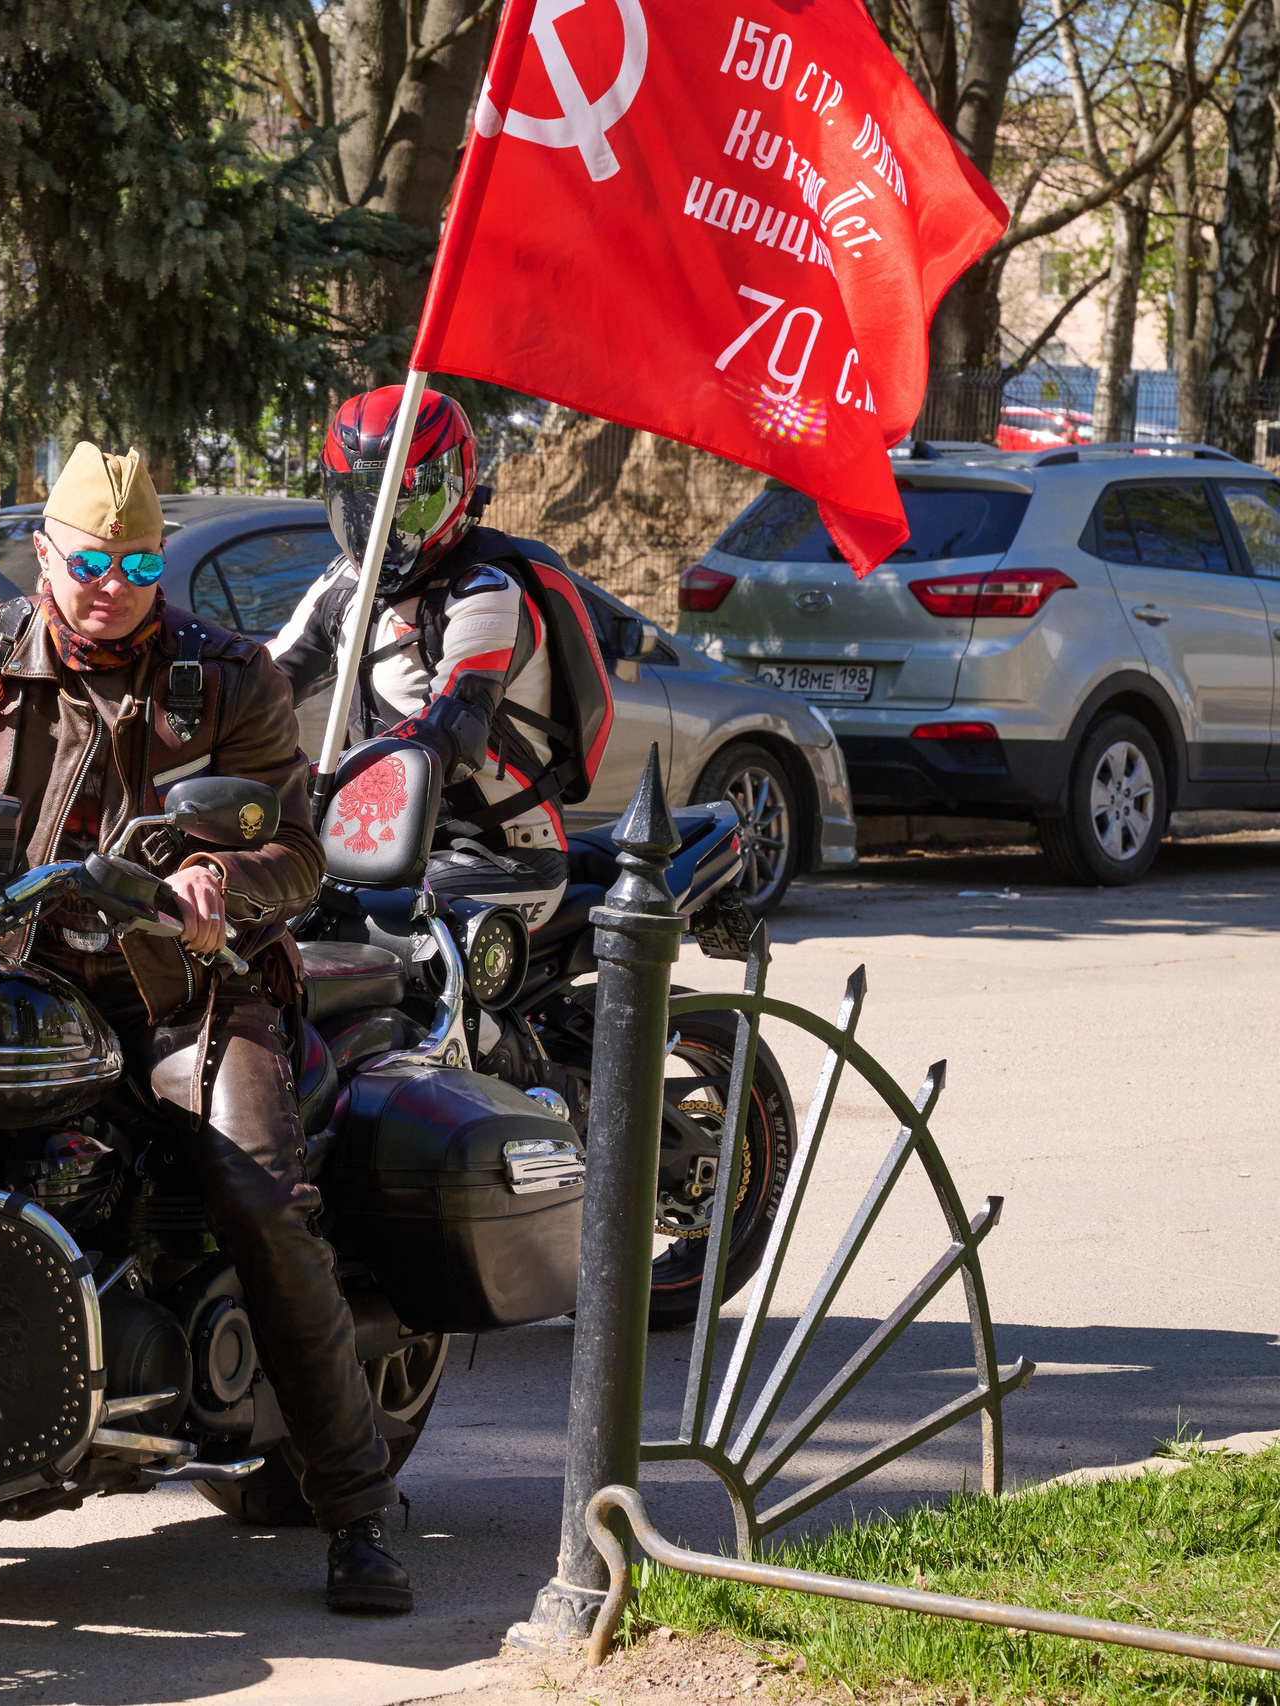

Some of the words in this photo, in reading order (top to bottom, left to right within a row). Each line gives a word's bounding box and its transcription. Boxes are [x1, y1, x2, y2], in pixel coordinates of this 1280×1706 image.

[720, 16, 792, 90] 150
[714, 284, 823, 402] 79
[839, 668, 867, 685] 198
[765, 1116, 787, 1220] MICHELIN
